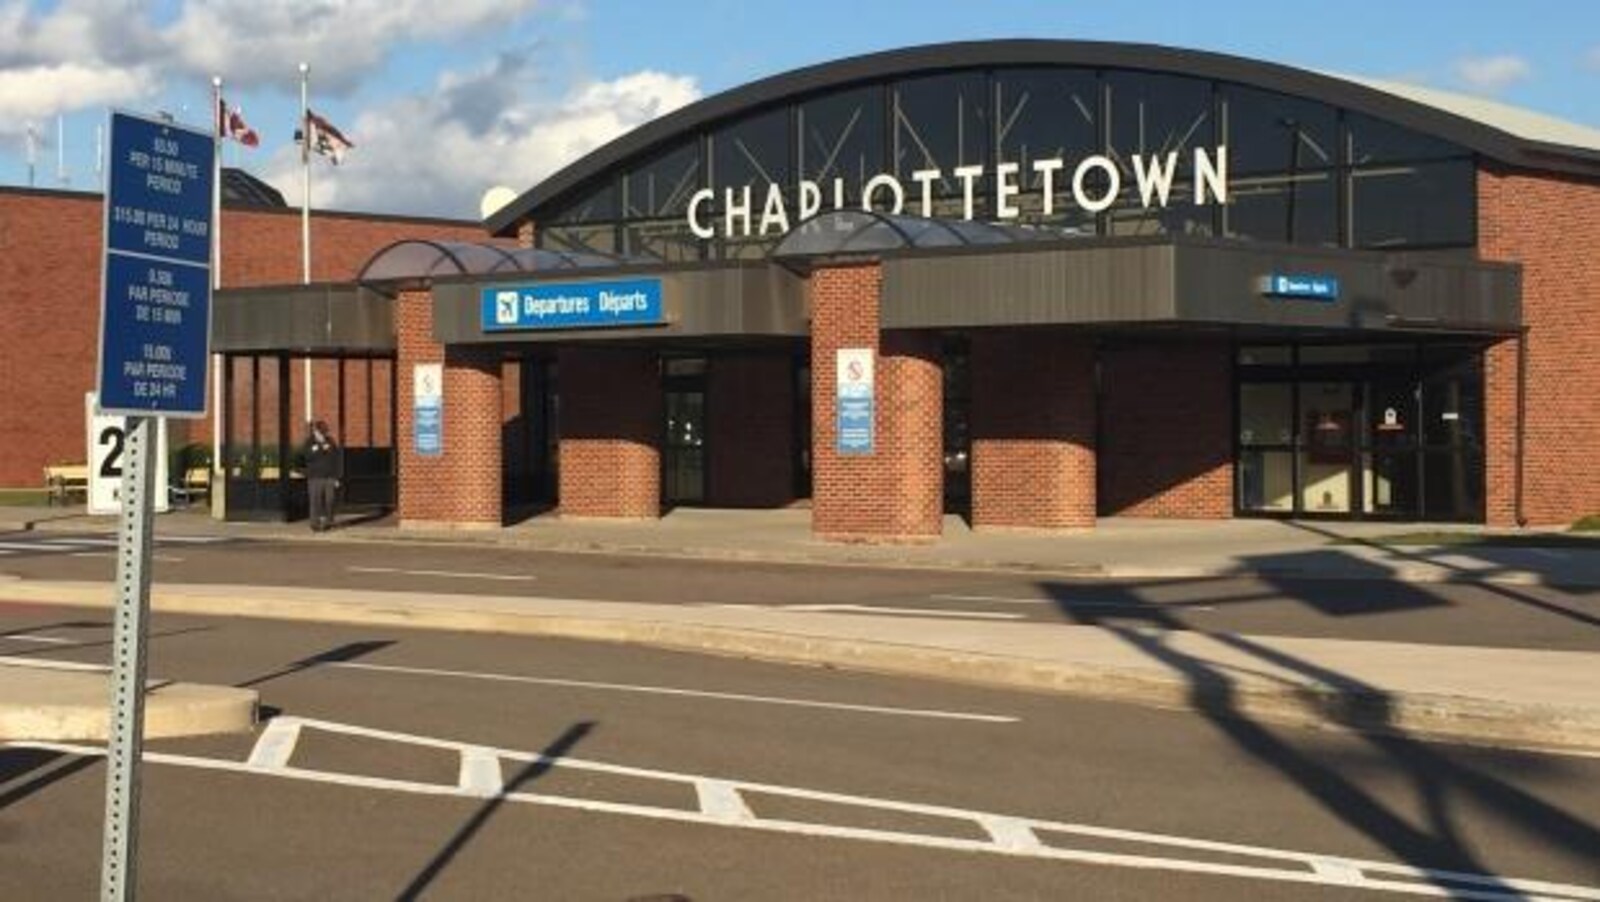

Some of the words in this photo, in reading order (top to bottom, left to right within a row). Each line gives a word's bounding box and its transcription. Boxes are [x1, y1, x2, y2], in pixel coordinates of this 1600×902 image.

[129, 151, 150, 169] PER
[151, 157, 164, 172] 15
[165, 158, 199, 180] MINUTE
[146, 172, 182, 195] PERIOD
[687, 146, 1227, 239] CHARLOTTETOWN
[147, 211, 166, 228] PER
[183, 218, 208, 237] HOUR
[144, 230, 179, 249] PERIOD
[128, 285, 148, 301] PAR
[136, 305, 150, 322] DE
[524, 295, 590, 318] Departures
[598, 290, 648, 316] Départs
[123, 361, 145, 377] PAR
[134, 382, 148, 397] DE
